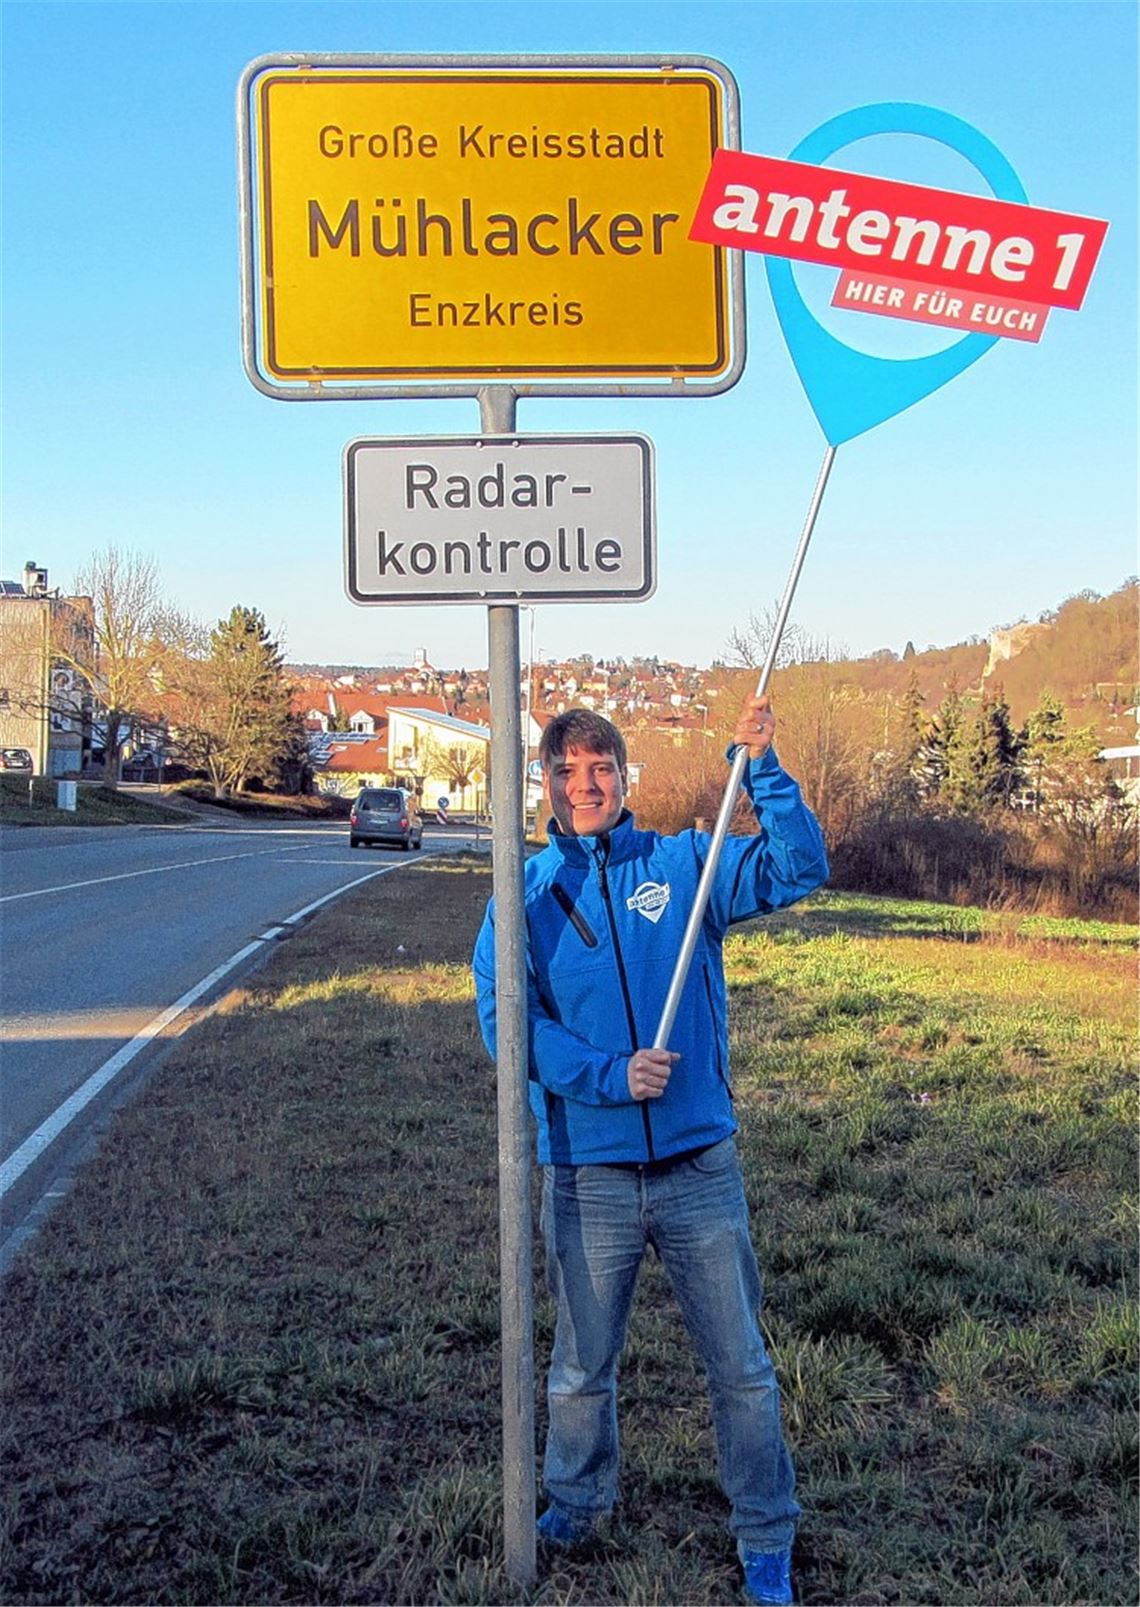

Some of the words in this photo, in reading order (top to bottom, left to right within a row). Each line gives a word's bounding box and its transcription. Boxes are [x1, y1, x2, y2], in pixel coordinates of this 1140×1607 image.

[319, 125, 438, 159] Große
[459, 124, 665, 159] Kreisstadt
[307, 197, 680, 257] Mühlacker
[712, 184, 1035, 283] antenne
[1052, 232, 1086, 291] 1
[409, 294, 585, 327] Enzkreis
[844, 279, 906, 309] HIER
[912, 289, 961, 319] FÜR
[969, 302, 1038, 332] EUCH
[405, 462, 593, 509] Radar-
[377, 527, 623, 575] kontrolle
